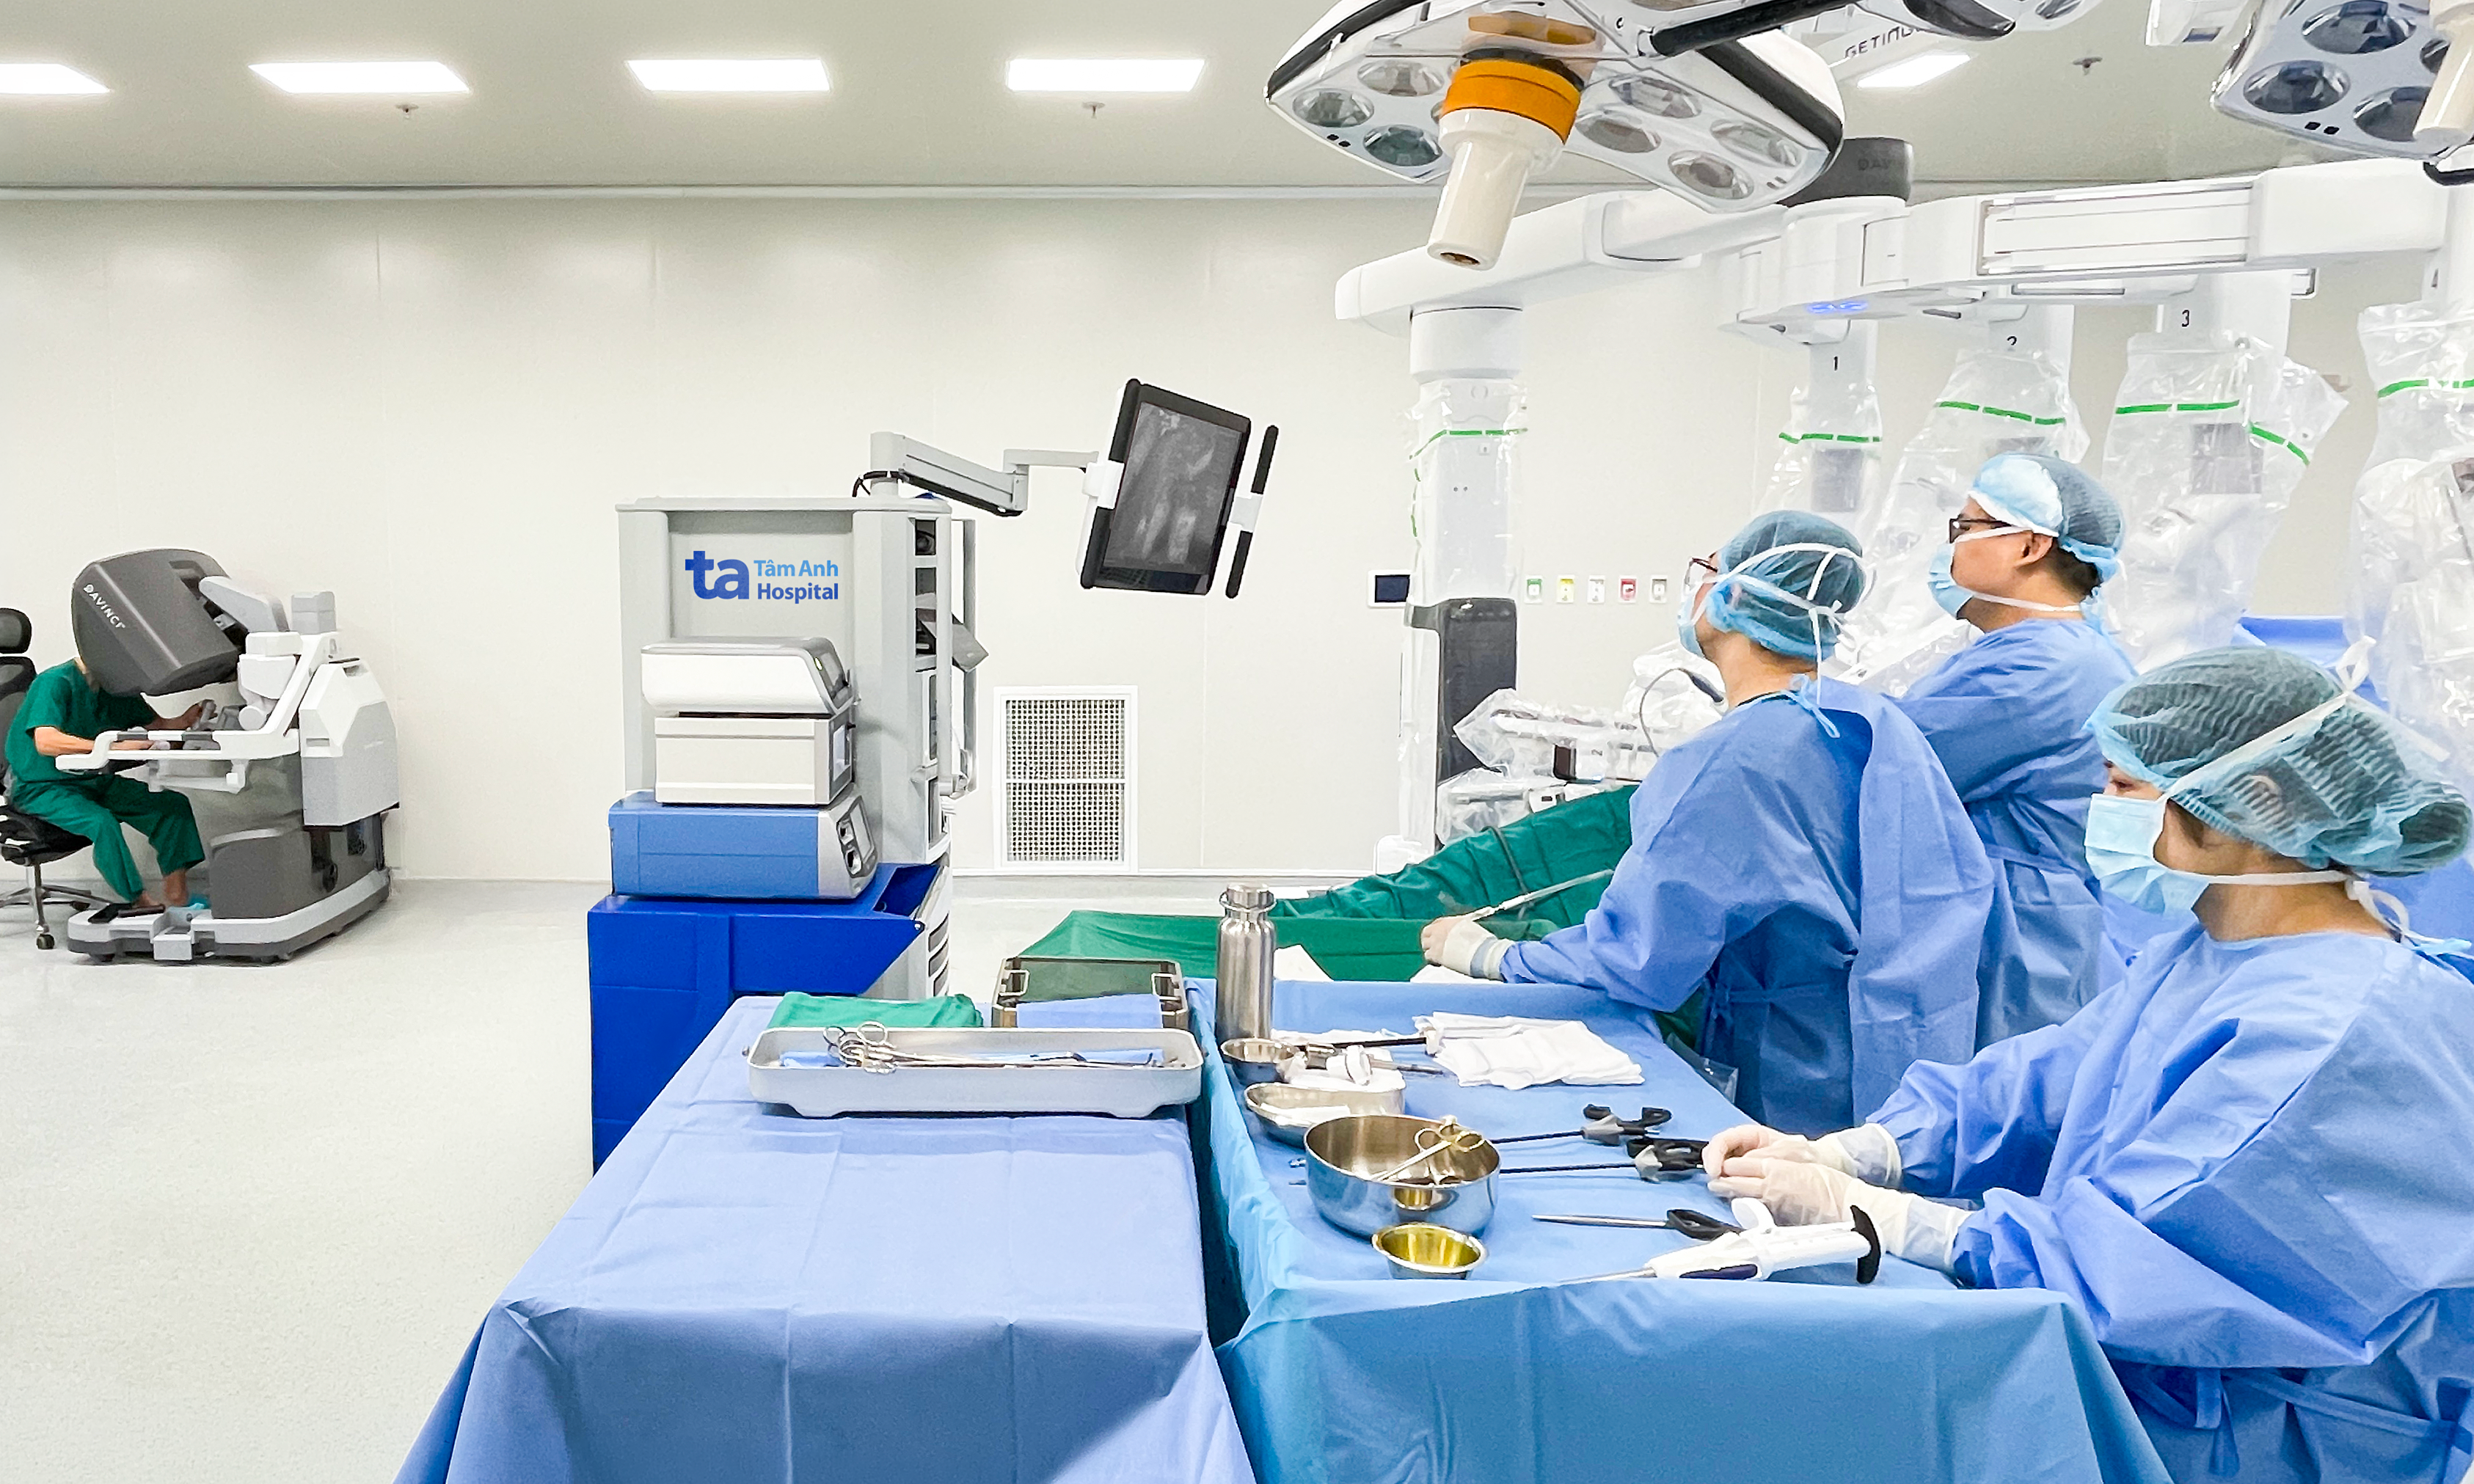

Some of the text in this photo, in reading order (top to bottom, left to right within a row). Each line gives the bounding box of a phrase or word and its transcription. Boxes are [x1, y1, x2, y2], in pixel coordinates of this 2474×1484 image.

[1844, 26, 1922, 59] GETING
[2181, 309, 2190, 327] 3
[1833, 356, 1839, 371] 1
[685, 550, 750, 600] ta
[753, 559, 839, 577] Tâm Anh
[757, 582, 839, 604] Hospital
